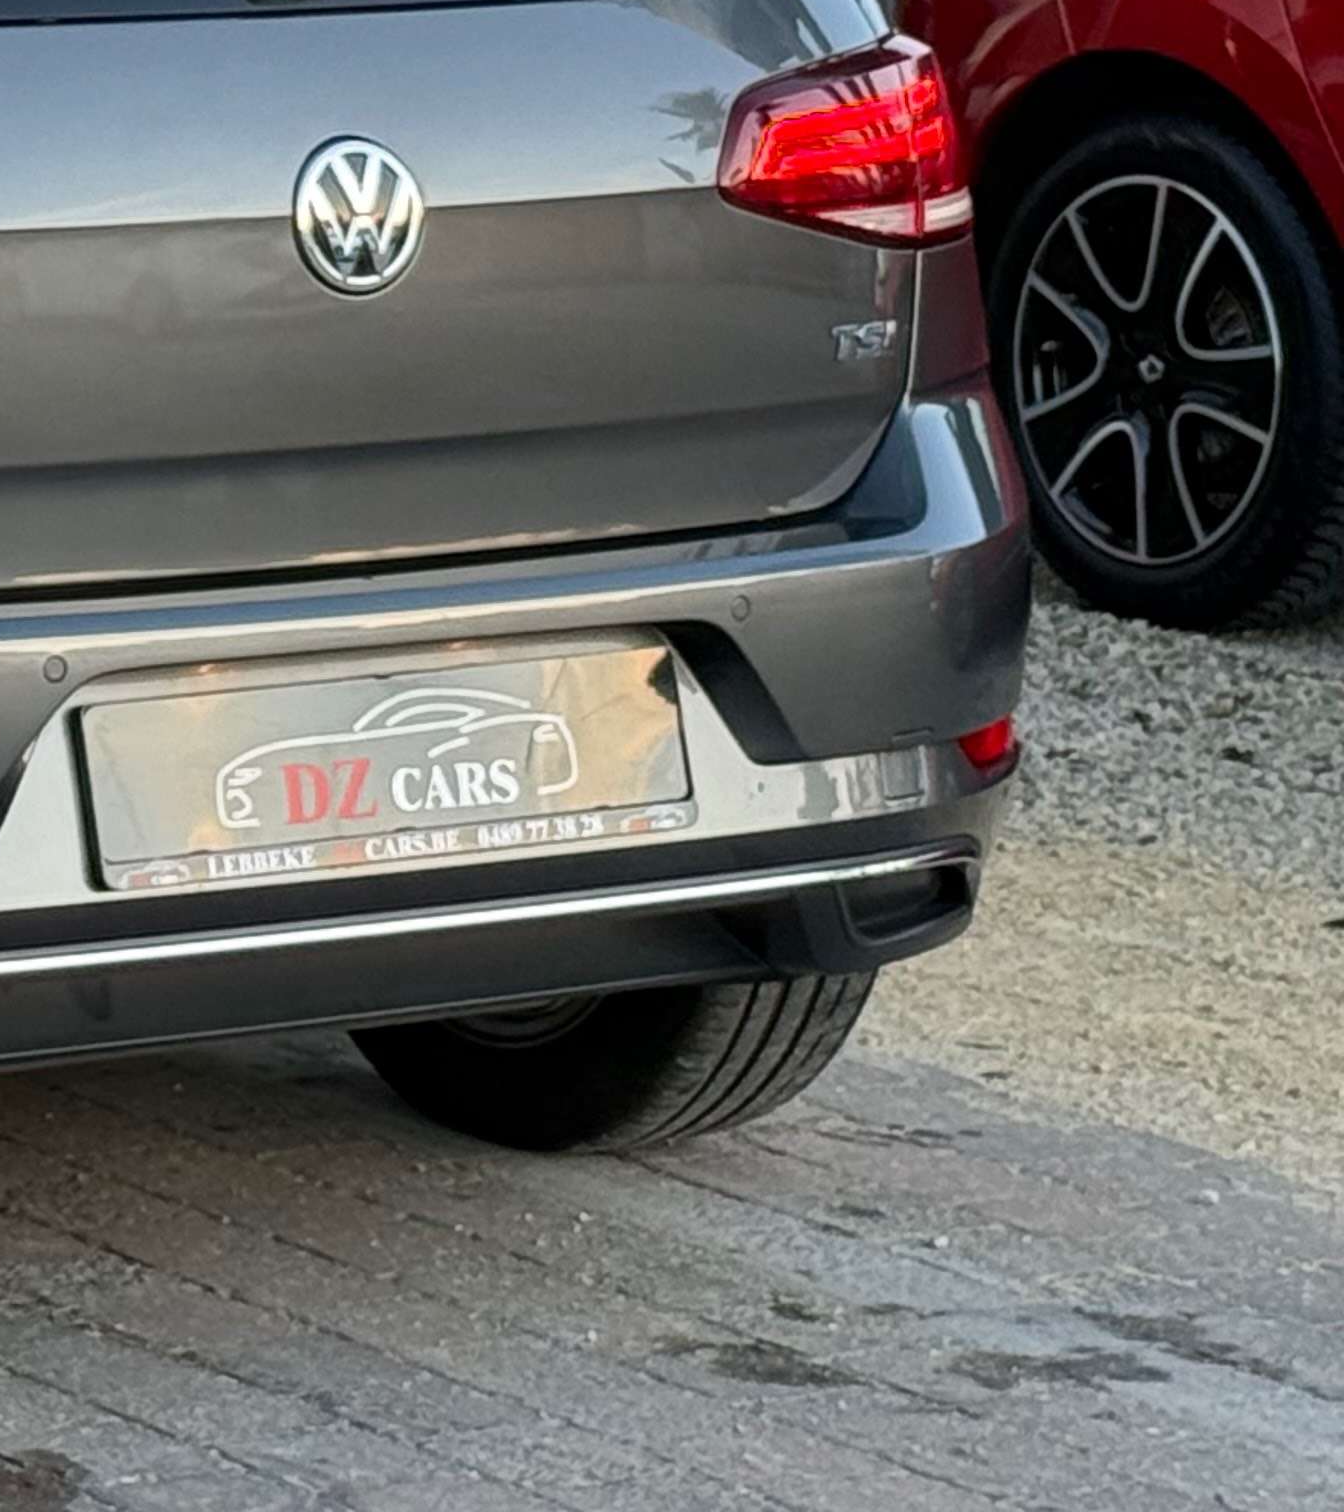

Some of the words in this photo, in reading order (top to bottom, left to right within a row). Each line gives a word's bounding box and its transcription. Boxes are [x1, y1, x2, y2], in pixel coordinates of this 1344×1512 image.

[296, 140, 424, 292] VW
[281, 756, 379, 825] DZ
[391, 758, 520, 813] CARS
